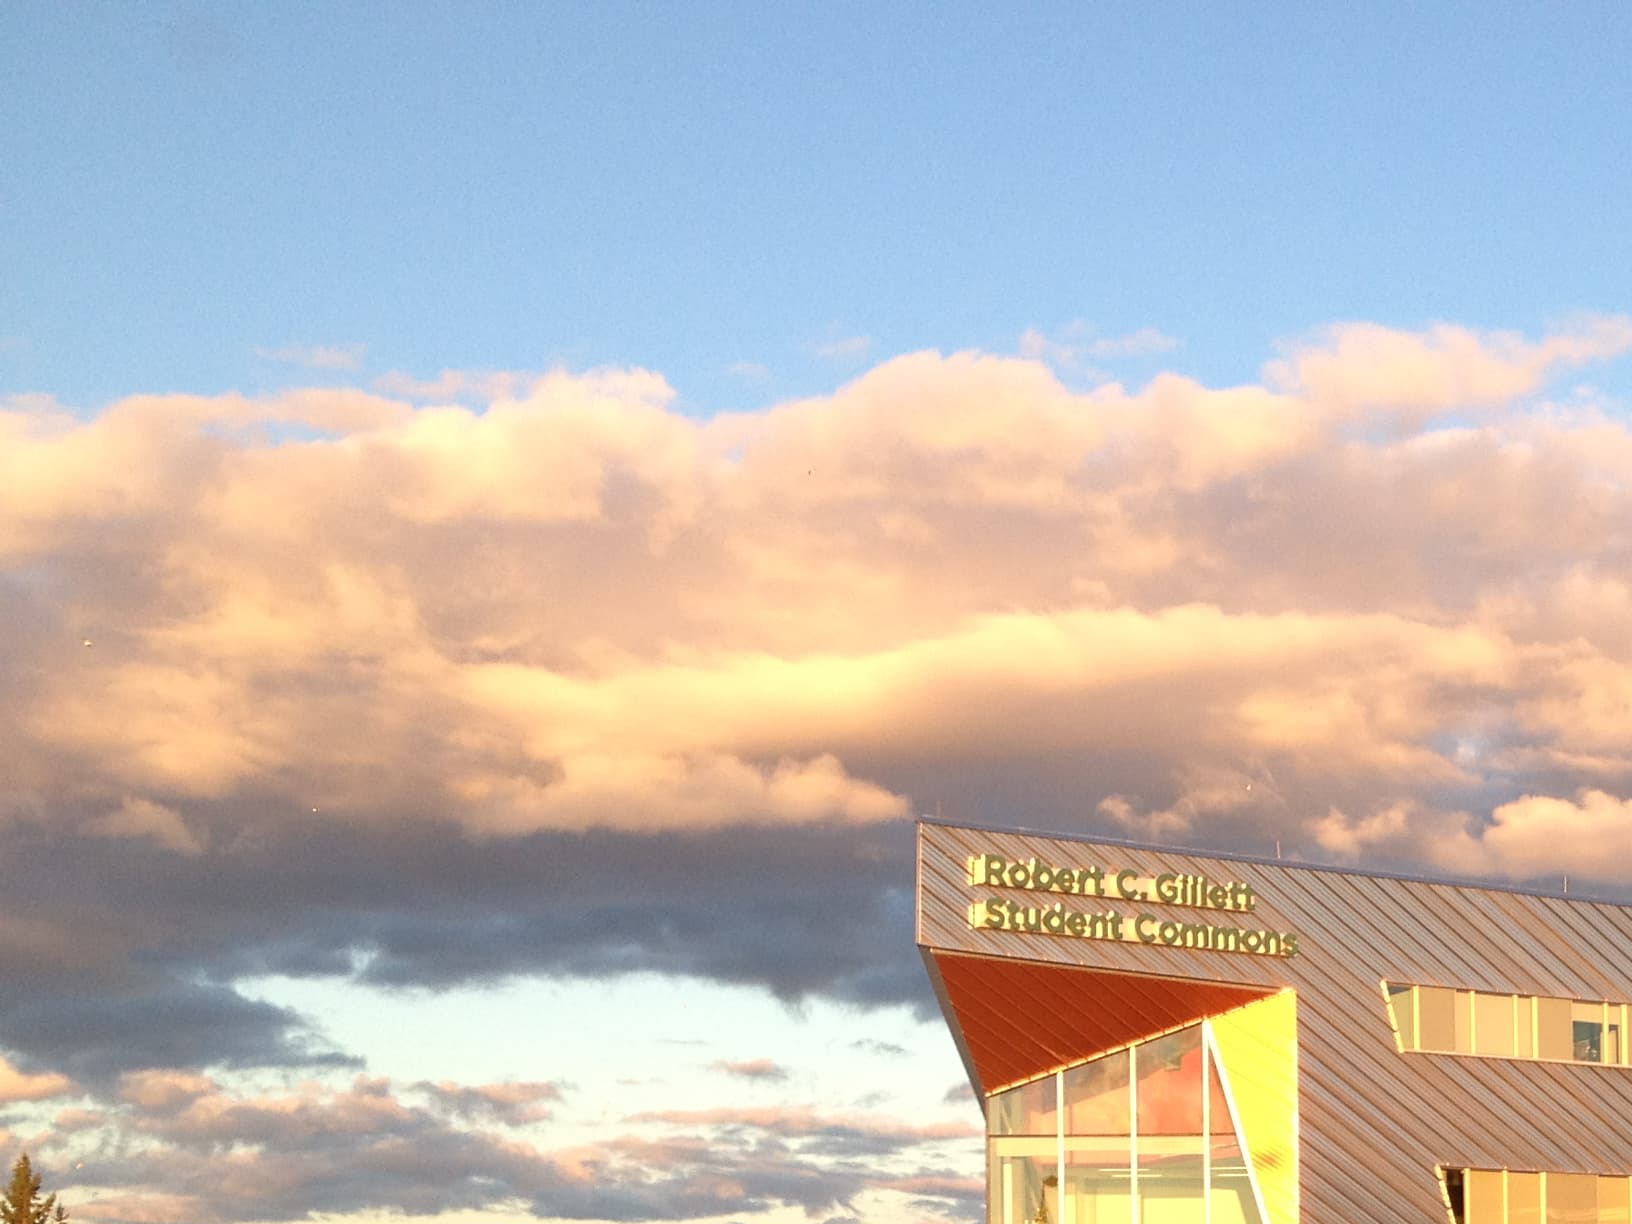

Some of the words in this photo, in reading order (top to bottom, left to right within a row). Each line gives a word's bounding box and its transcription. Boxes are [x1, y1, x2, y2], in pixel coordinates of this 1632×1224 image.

[984, 854, 1105, 896] Robert
[1116, 868, 1148, 900] C.
[1155, 872, 1256, 912] Gillett
[984, 896, 1123, 939] Student
[1134, 912, 1300, 957] Commons
